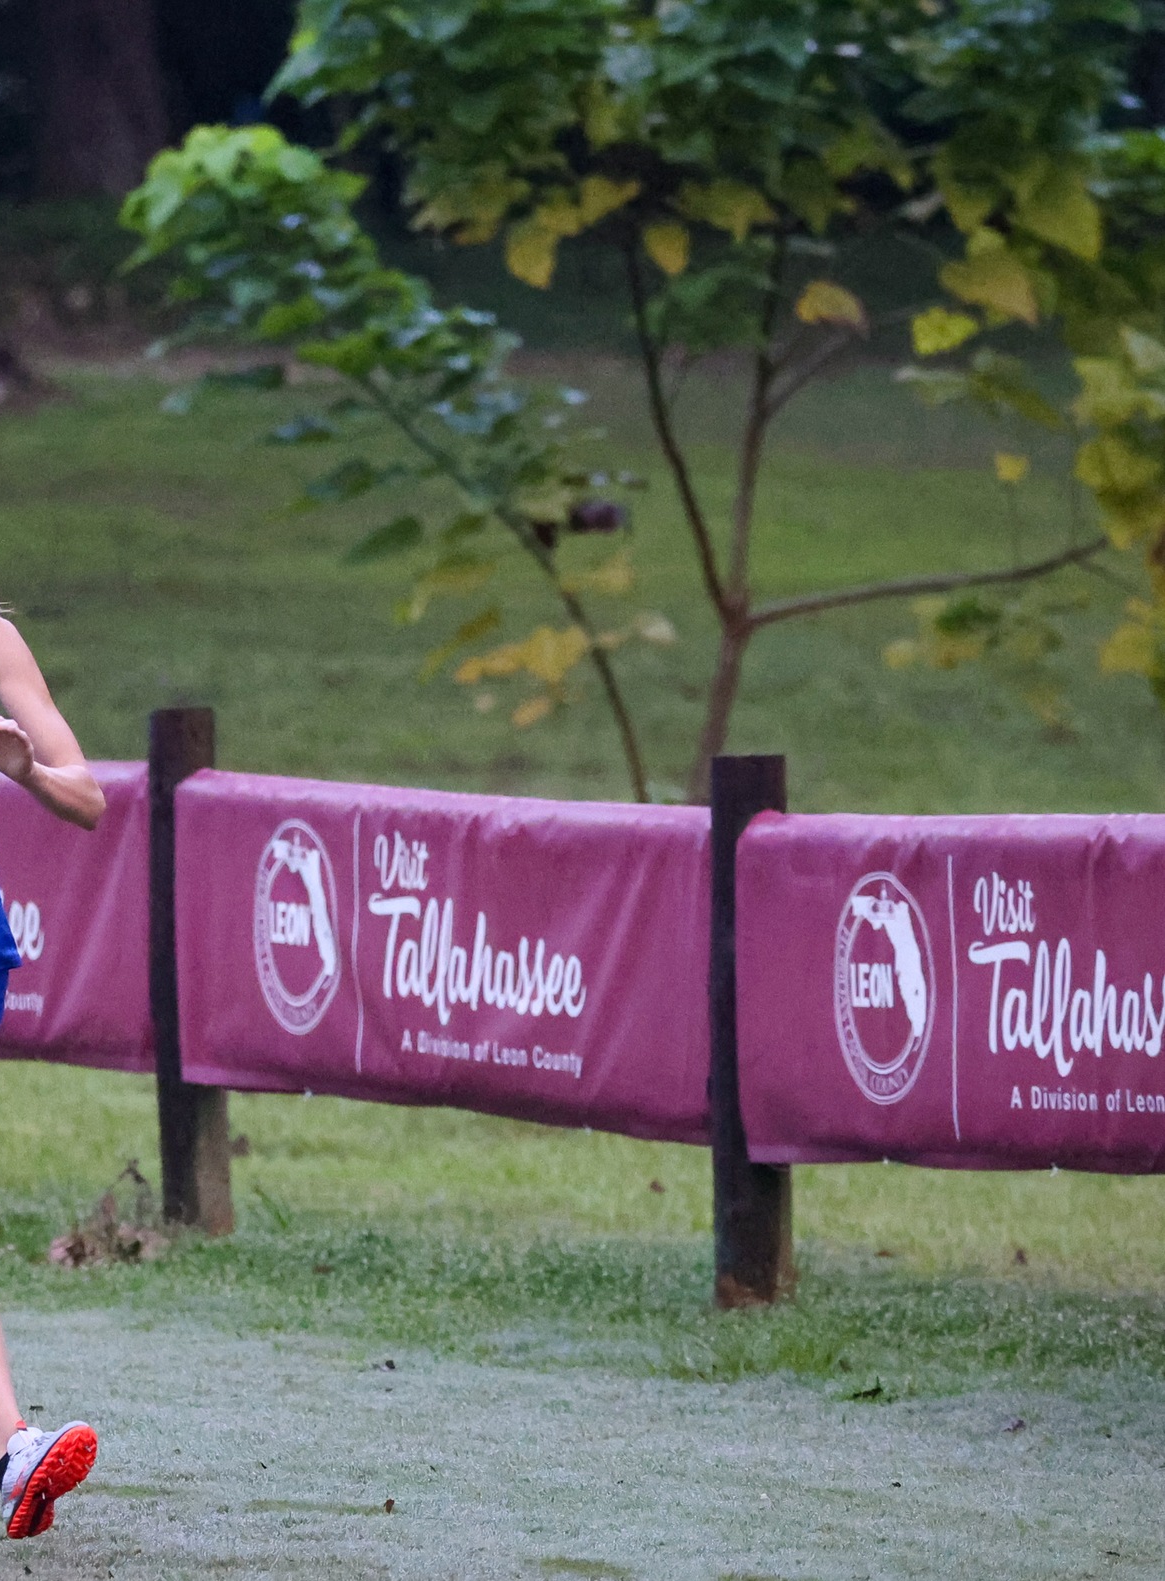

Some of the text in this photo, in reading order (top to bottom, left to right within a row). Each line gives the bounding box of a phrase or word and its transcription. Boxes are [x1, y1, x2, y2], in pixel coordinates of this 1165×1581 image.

[374, 831, 429, 890] Visit
[270, 901, 311, 946] LEON
[974, 871, 1036, 936] Visit
[368, 893, 586, 1026] Tallahassee
[850, 963, 894, 1008] LEON
[968, 937, 1165, 1077] Tallahas
[401, 1028, 584, 1079] A Division of Leon County
[1010, 1085, 1165, 1113] A Division of Leon
